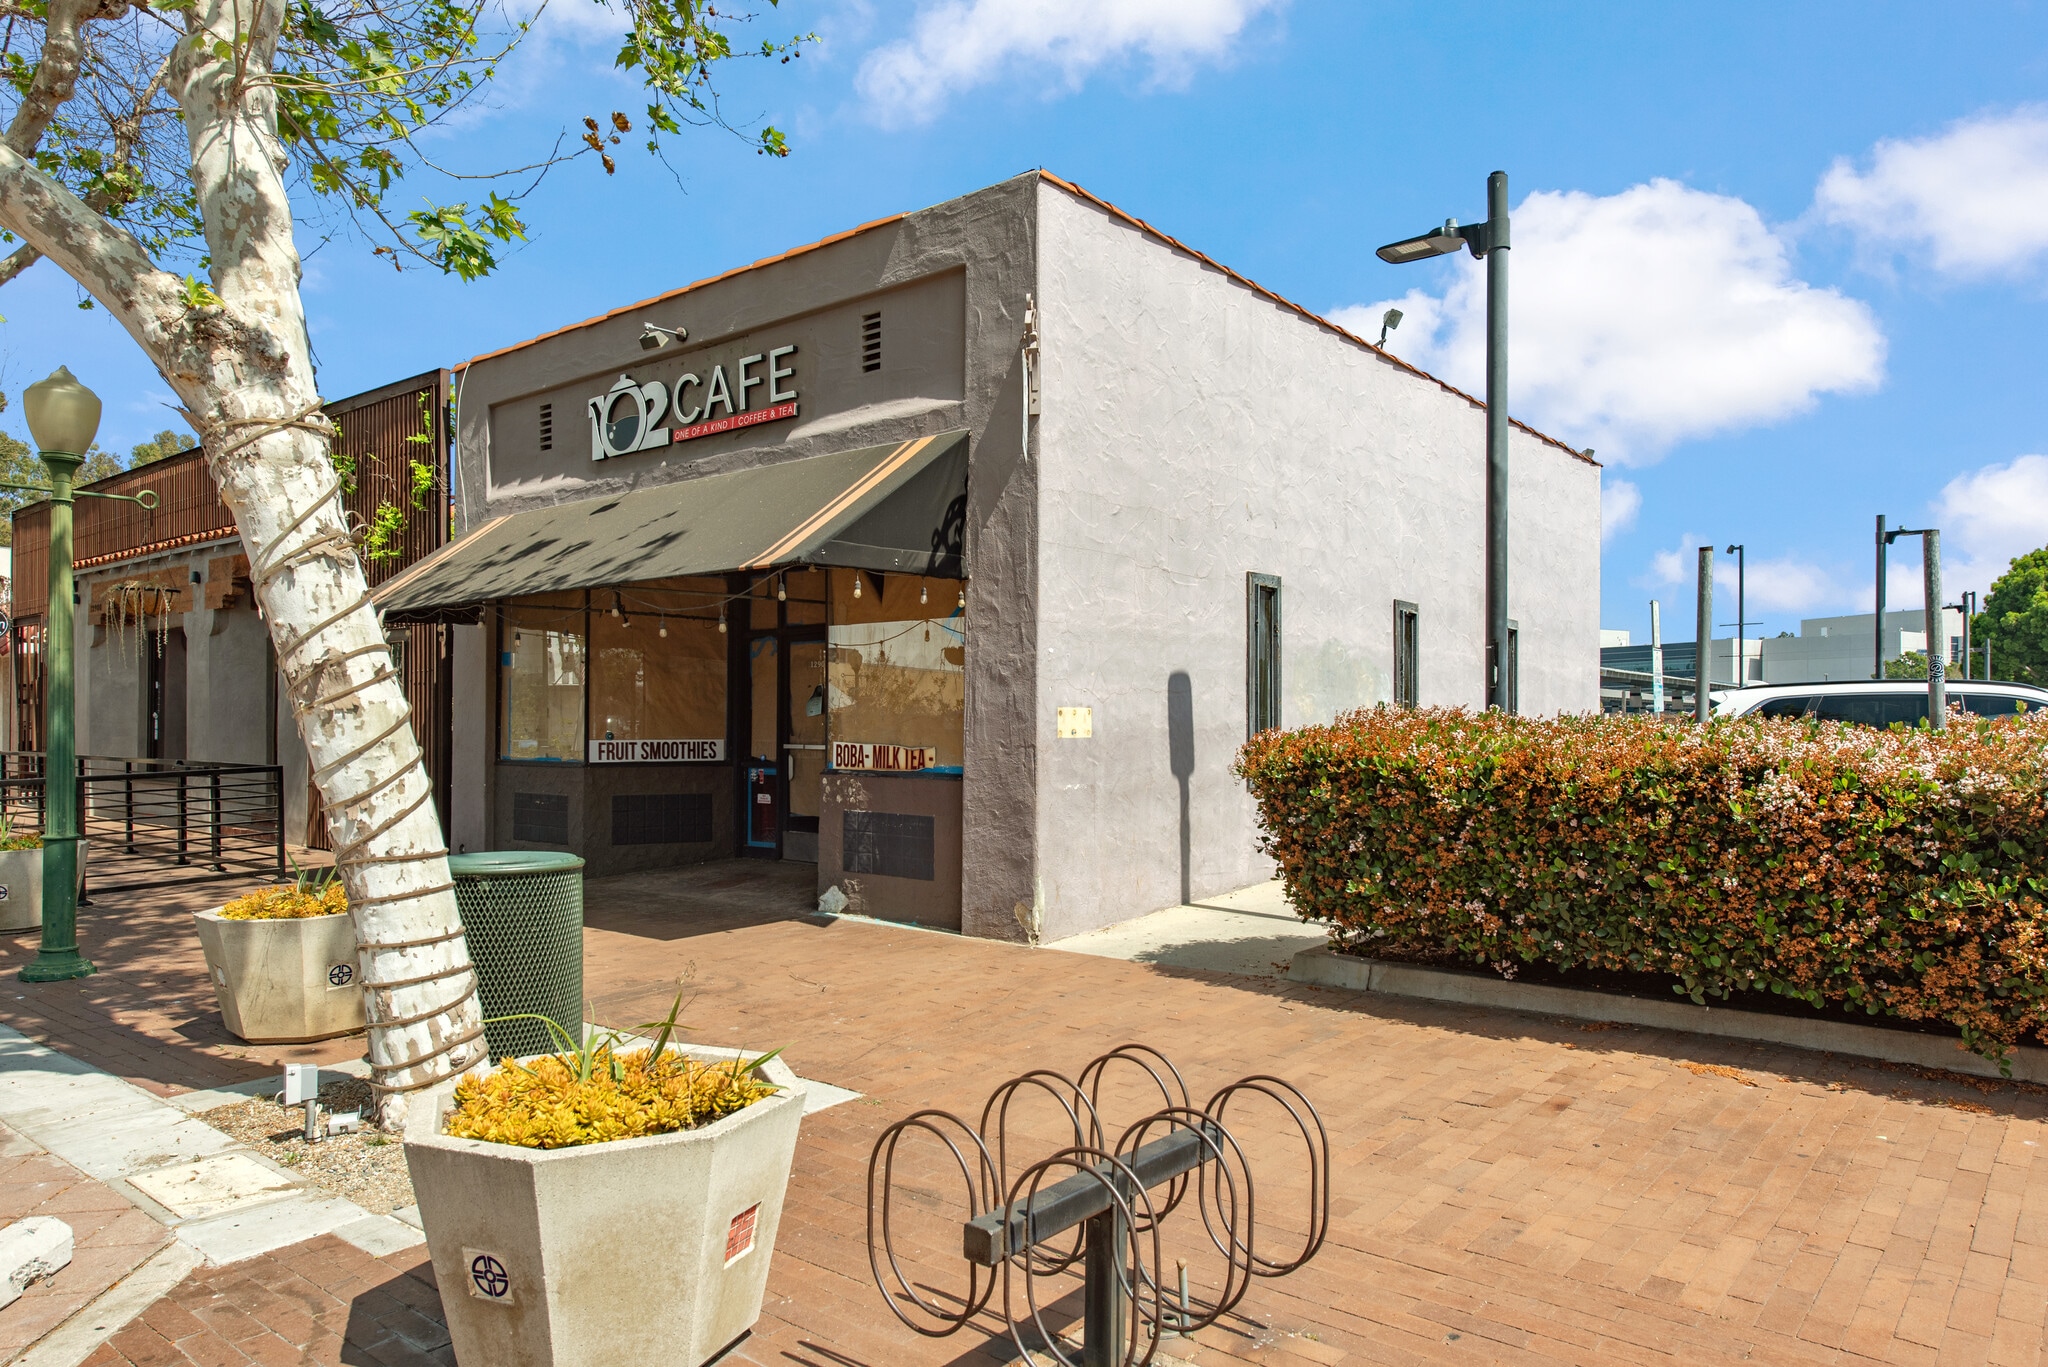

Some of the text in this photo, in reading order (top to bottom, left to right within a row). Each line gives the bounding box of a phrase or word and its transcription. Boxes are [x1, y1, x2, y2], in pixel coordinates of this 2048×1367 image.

[673, 345, 798, 424] CAFE
[674, 429, 689, 440] ONE
[691, 426, 701, 436] OF
[703, 425, 709, 434] A
[710, 420, 728, 432] KIND
[738, 410, 767, 426] COFFEE
[769, 409, 776, 418] &
[779, 406, 793, 416] TEA
[598, 741, 717, 760] FRUIT SMOOTHIES
[836, 744, 869, 768] BOBA-
[872, 745, 900, 769] MILK
[903, 748, 926, 770] TEA
